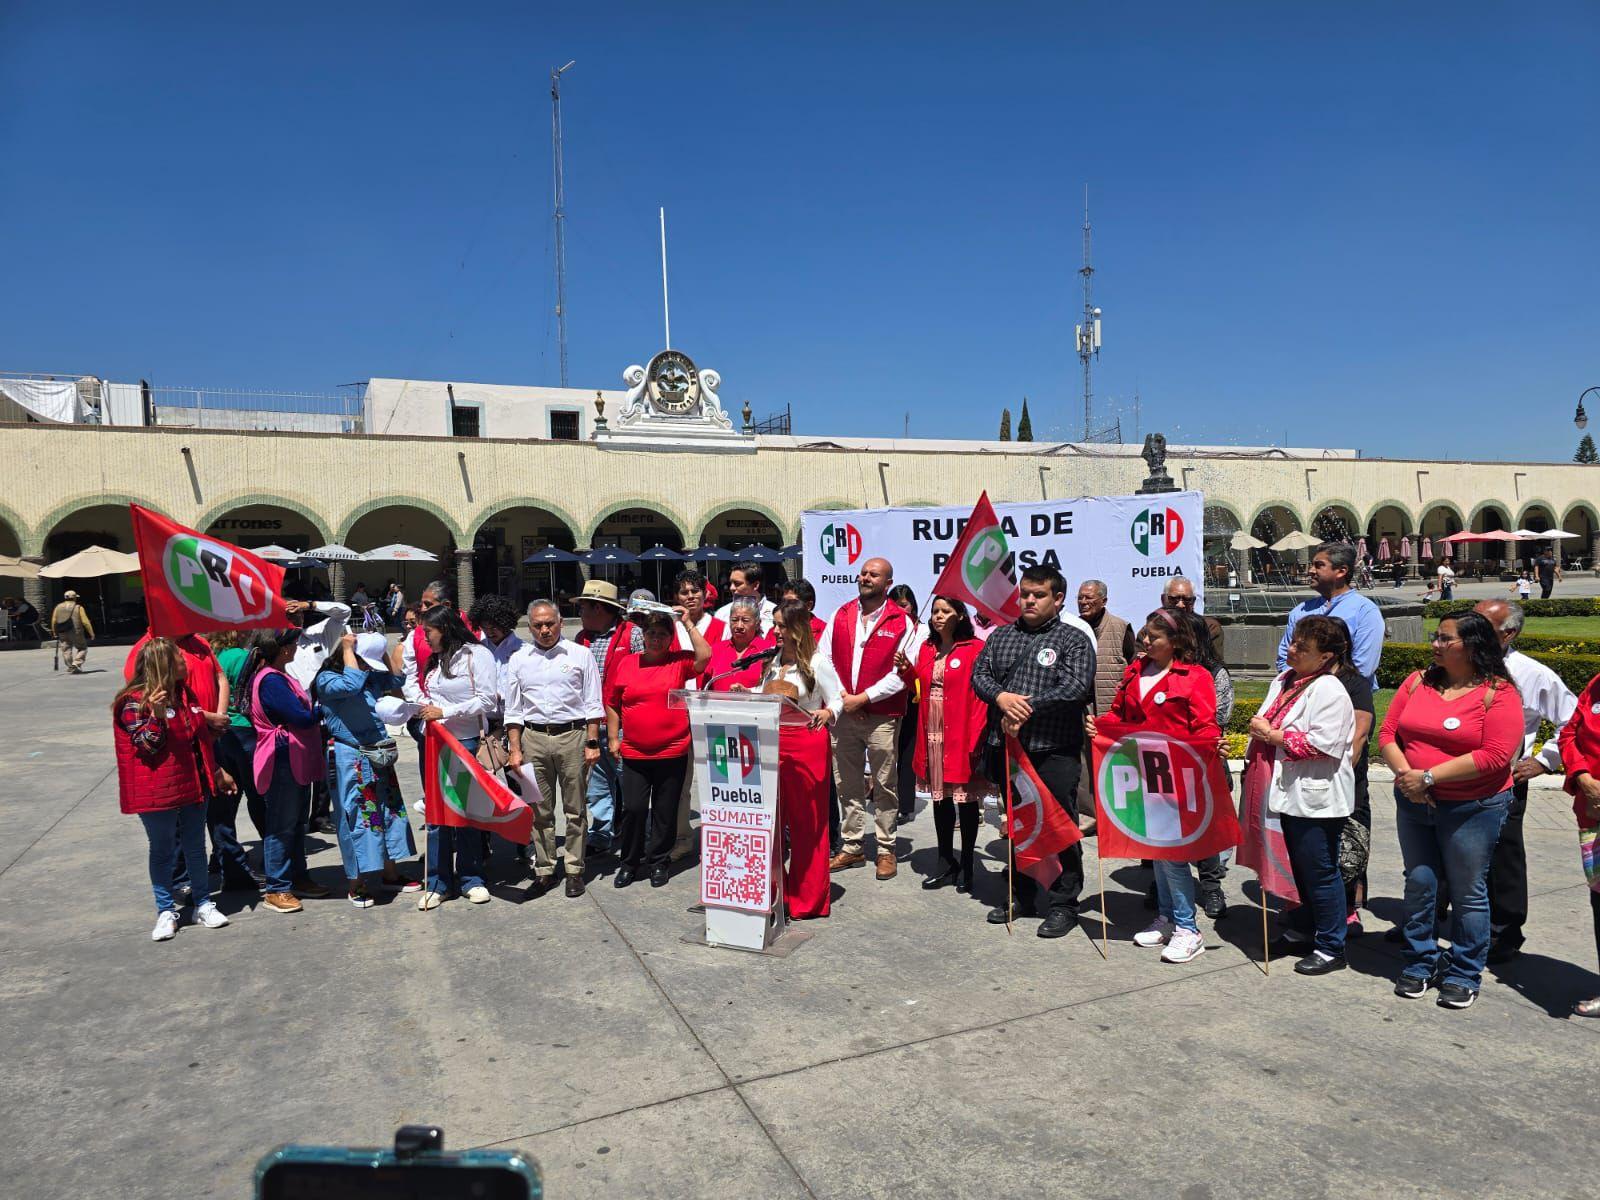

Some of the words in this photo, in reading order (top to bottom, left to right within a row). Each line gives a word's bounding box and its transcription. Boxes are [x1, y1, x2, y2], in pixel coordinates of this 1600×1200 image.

[822, 527, 858, 555] PRI
[912, 515, 1020, 541] RUA
[1030, 511, 1074, 537] DE
[1134, 513, 1178, 545] PRI
[175, 549, 257, 607] PRI
[1132, 565, 1184, 578] PUEBLA
[715, 736, 750, 767] PRI
[711, 786, 762, 804] Puebla
[1111, 750, 1197, 813] PRI
